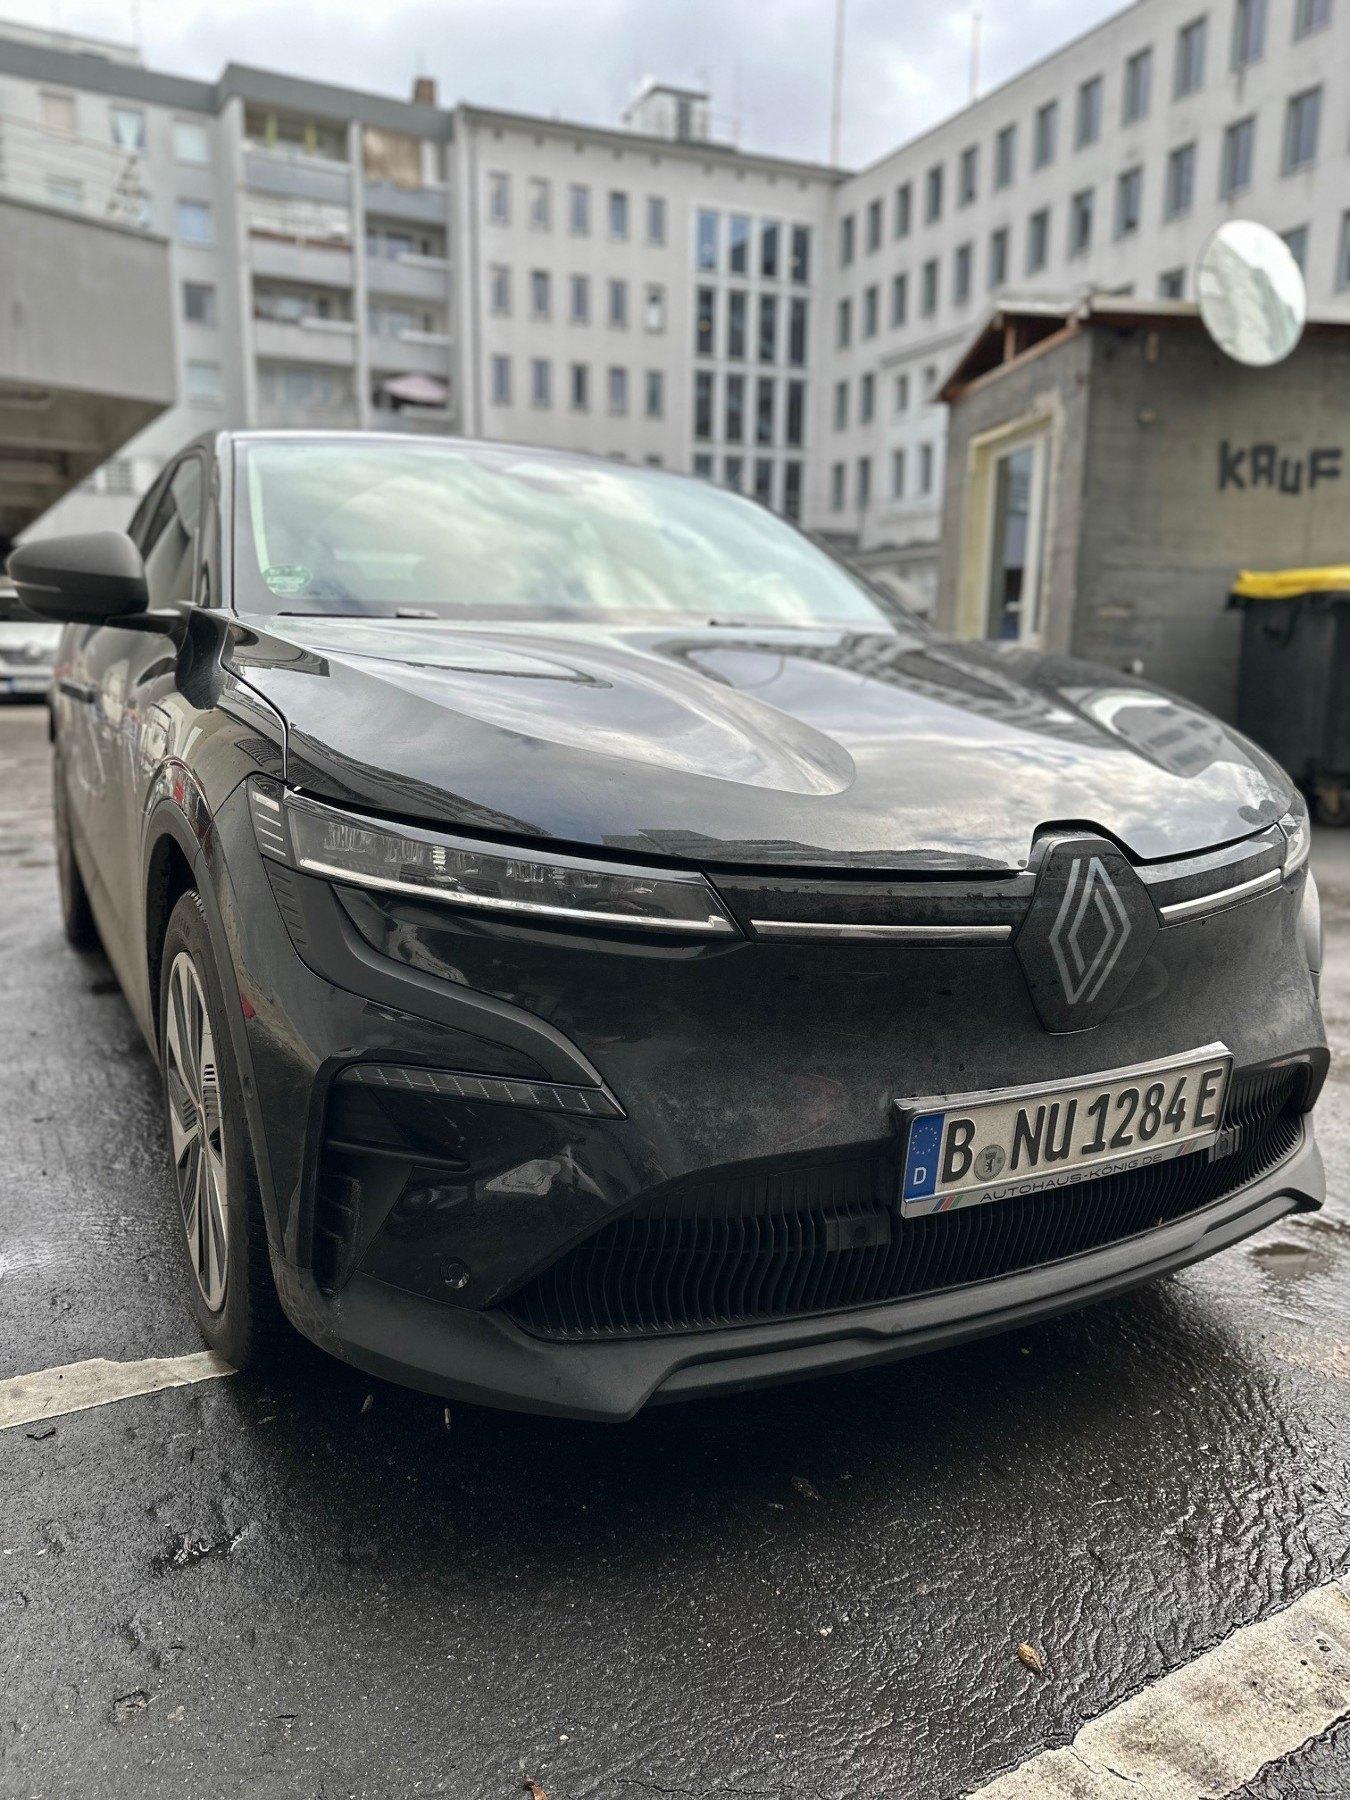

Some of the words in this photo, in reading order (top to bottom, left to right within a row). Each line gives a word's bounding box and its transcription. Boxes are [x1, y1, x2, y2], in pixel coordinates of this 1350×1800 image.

[1218, 439, 1342, 494] KAUF
[941, 1118, 976, 1184] B
[1009, 1099, 1079, 1171] NU
[912, 1166, 928, 1187] D
